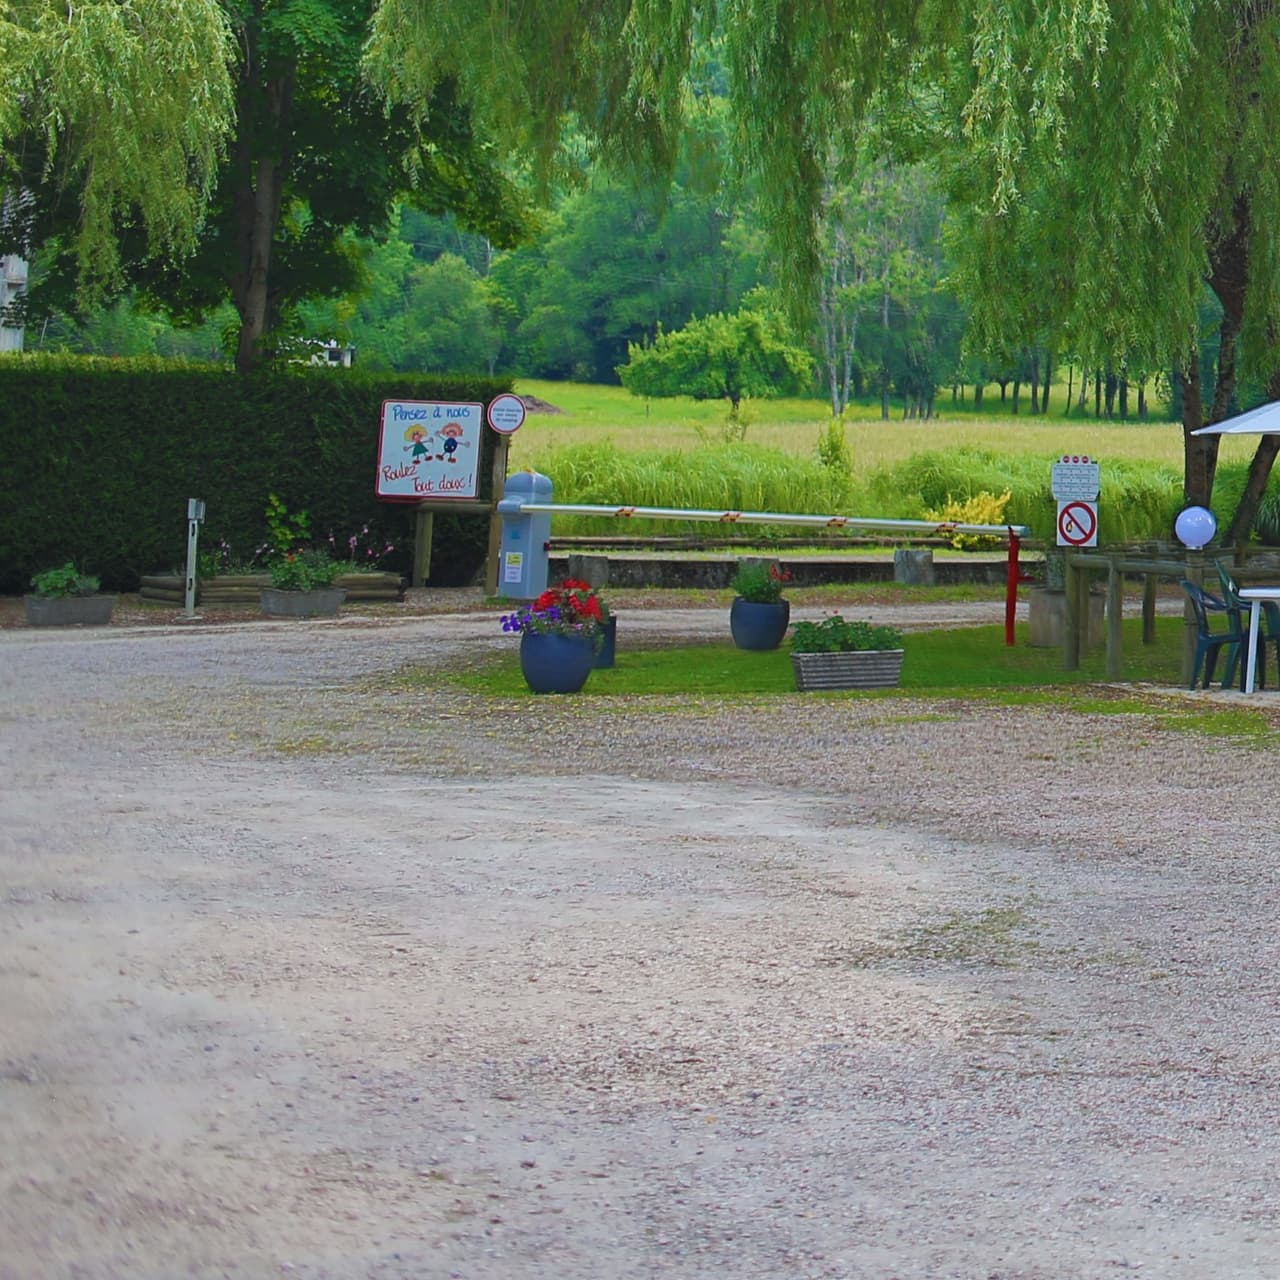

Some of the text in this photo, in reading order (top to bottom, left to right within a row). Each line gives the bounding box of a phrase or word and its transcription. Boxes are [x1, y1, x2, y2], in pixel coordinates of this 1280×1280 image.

[392, 405, 428, 421] Pensez
[446, 407, 470, 418] nous
[382, 462, 417, 482] Roulez
[411, 477, 434, 492] Tout
[438, 474, 466, 490] doux
